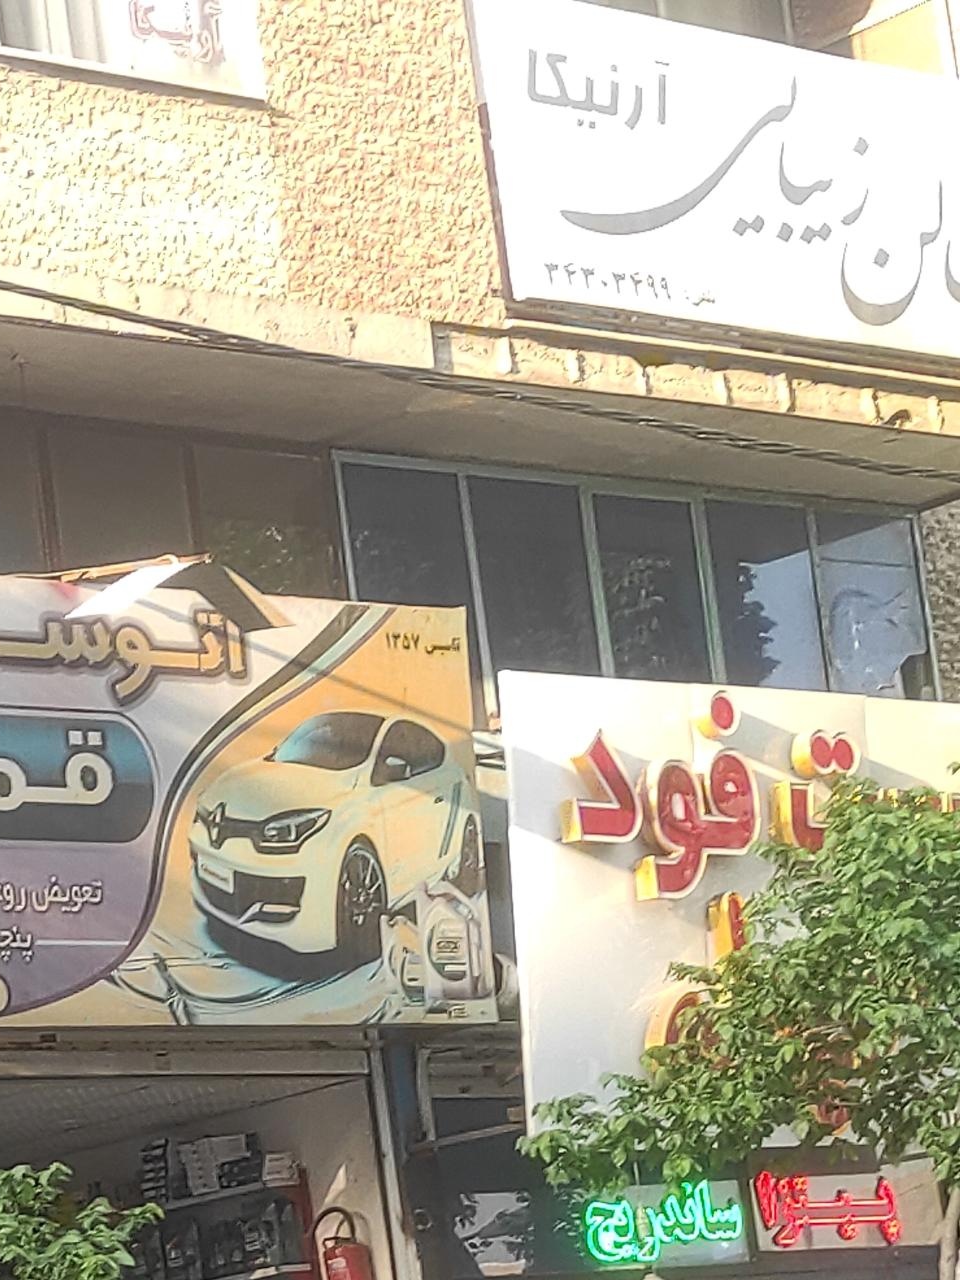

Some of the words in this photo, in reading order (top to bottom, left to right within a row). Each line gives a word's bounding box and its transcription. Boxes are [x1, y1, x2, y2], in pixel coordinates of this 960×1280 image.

[527, 48, 670, 130] آرنیکا
[543, 261, 672, 301] ۳۴۳۰۳۴۹۹
[560, 690, 762, 901] فود
[30, 873, 103, 913] تعویض
[754, 1170, 903, 1246] پیتزا
